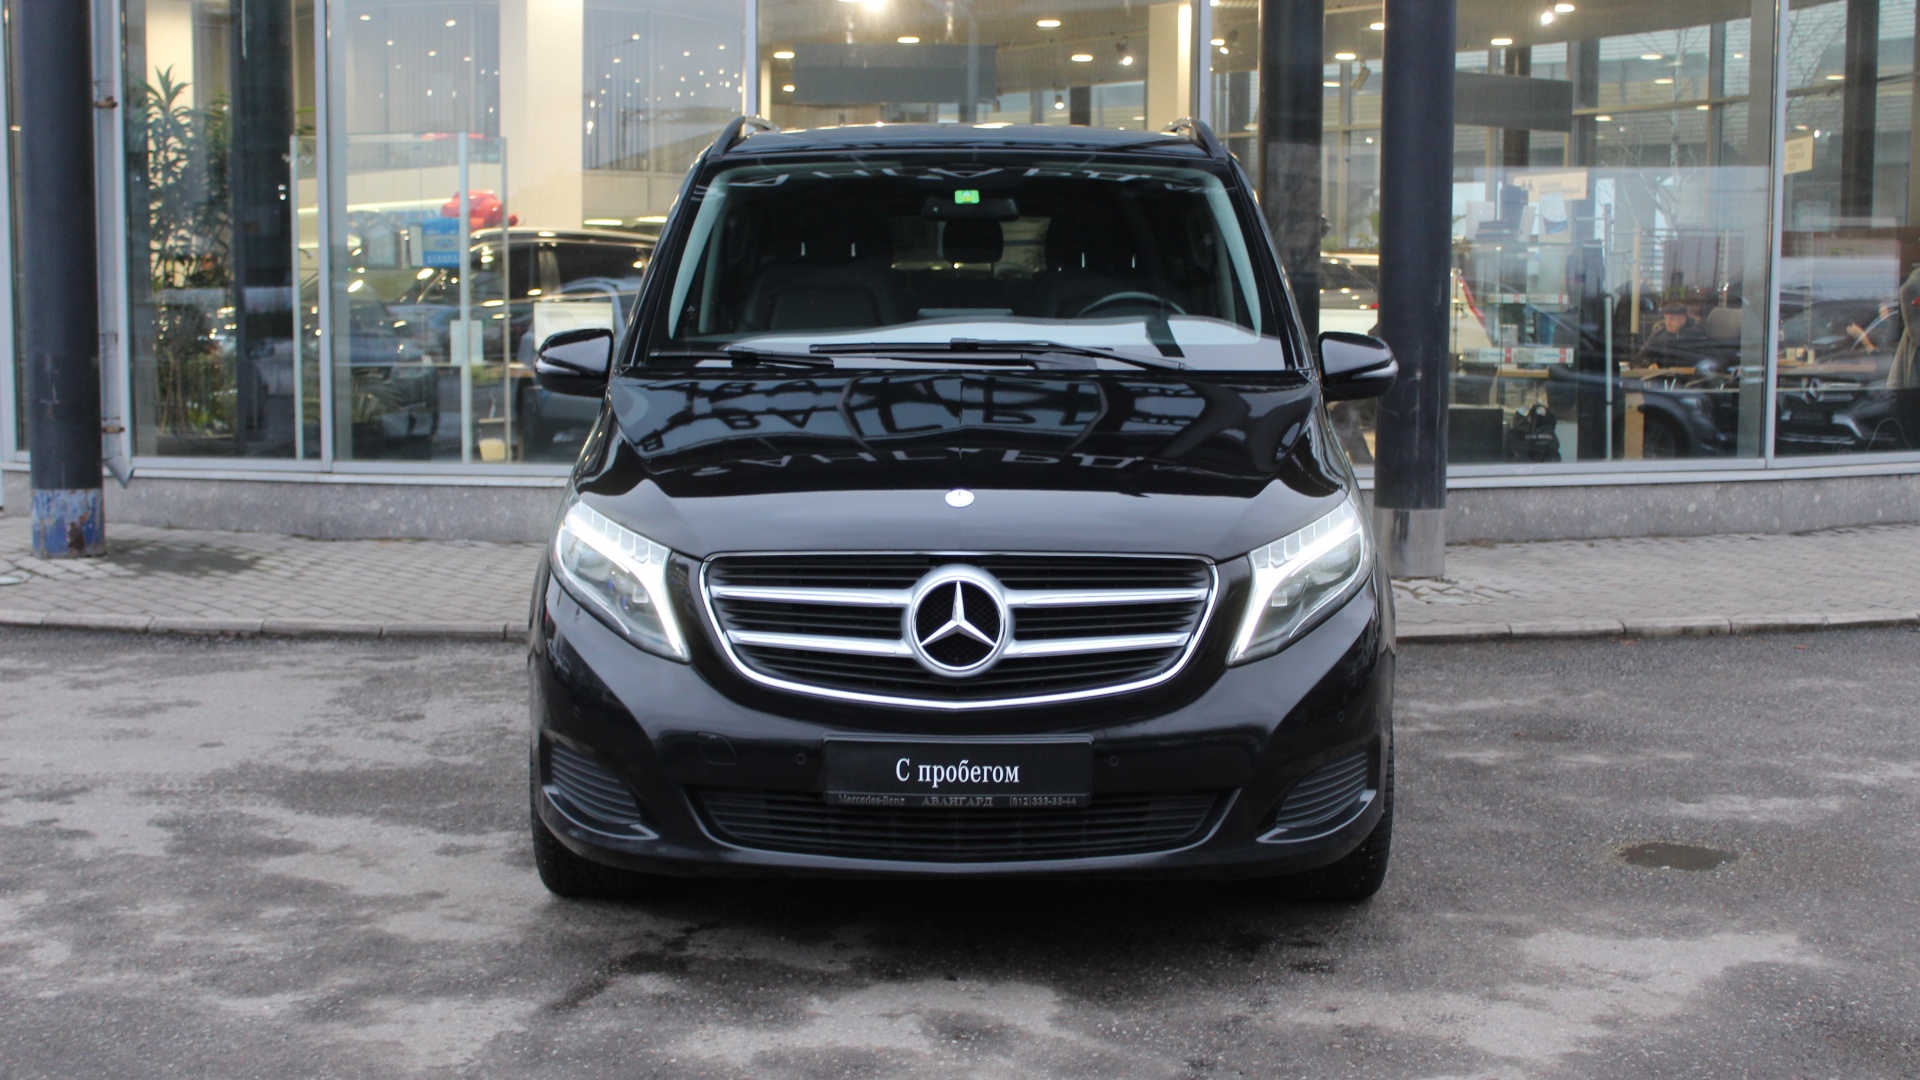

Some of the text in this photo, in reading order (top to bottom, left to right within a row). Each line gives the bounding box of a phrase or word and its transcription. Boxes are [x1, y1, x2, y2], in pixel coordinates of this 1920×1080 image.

[895, 757, 1020, 788] С пробегом
[838, 794, 1077, 807] Mercedes-Benz АВАНГАРД (812)333-33-44
